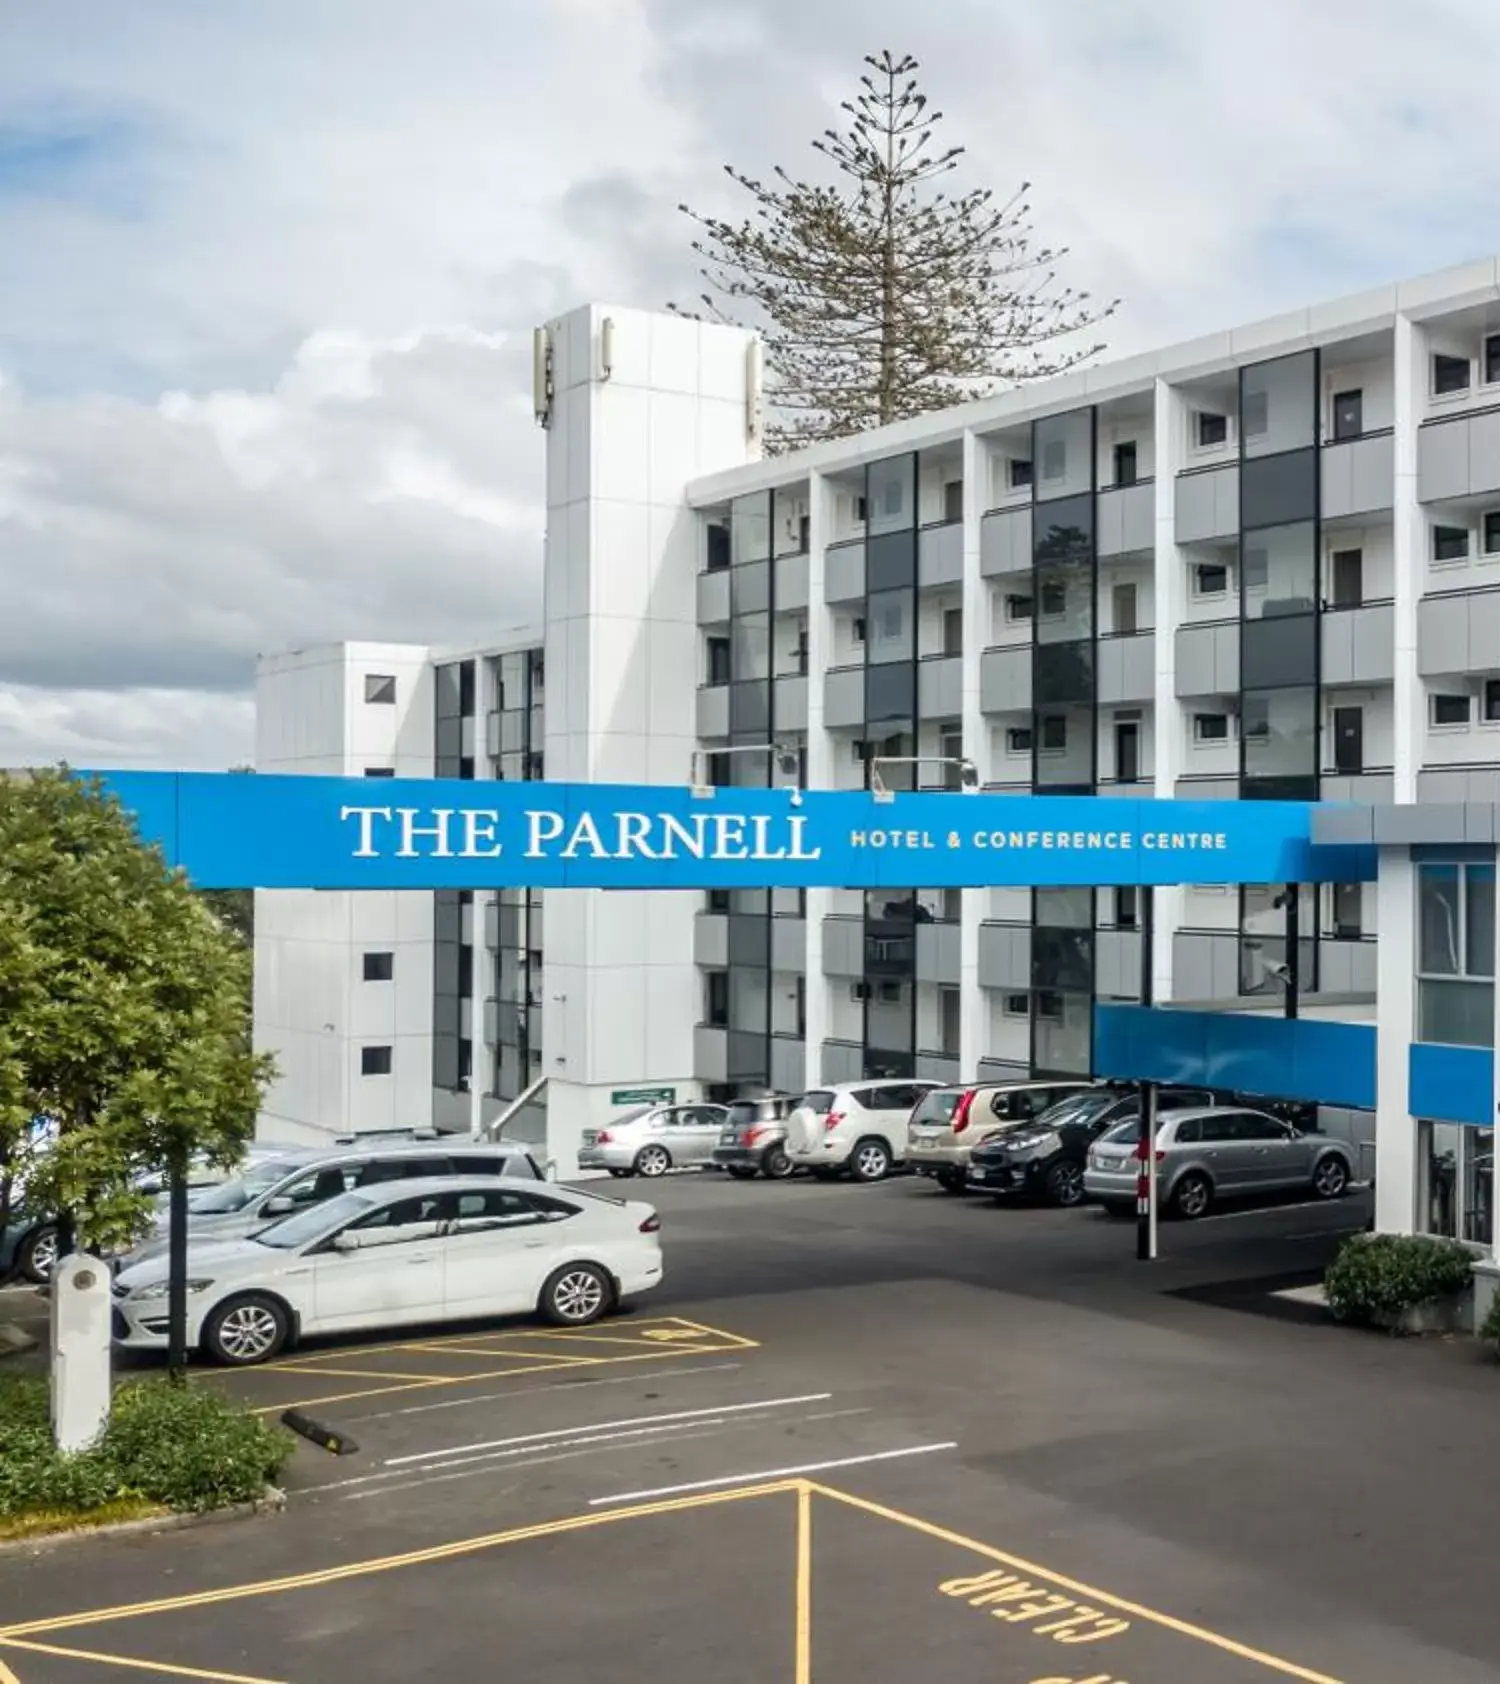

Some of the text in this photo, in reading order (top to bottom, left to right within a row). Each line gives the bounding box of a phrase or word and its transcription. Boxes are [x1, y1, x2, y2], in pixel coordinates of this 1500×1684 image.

[340, 805, 1227, 861] THE PARNELL HOTEL & CONFERENCE CENTRE
[937, 1568, 1131, 1644] CLEAR
